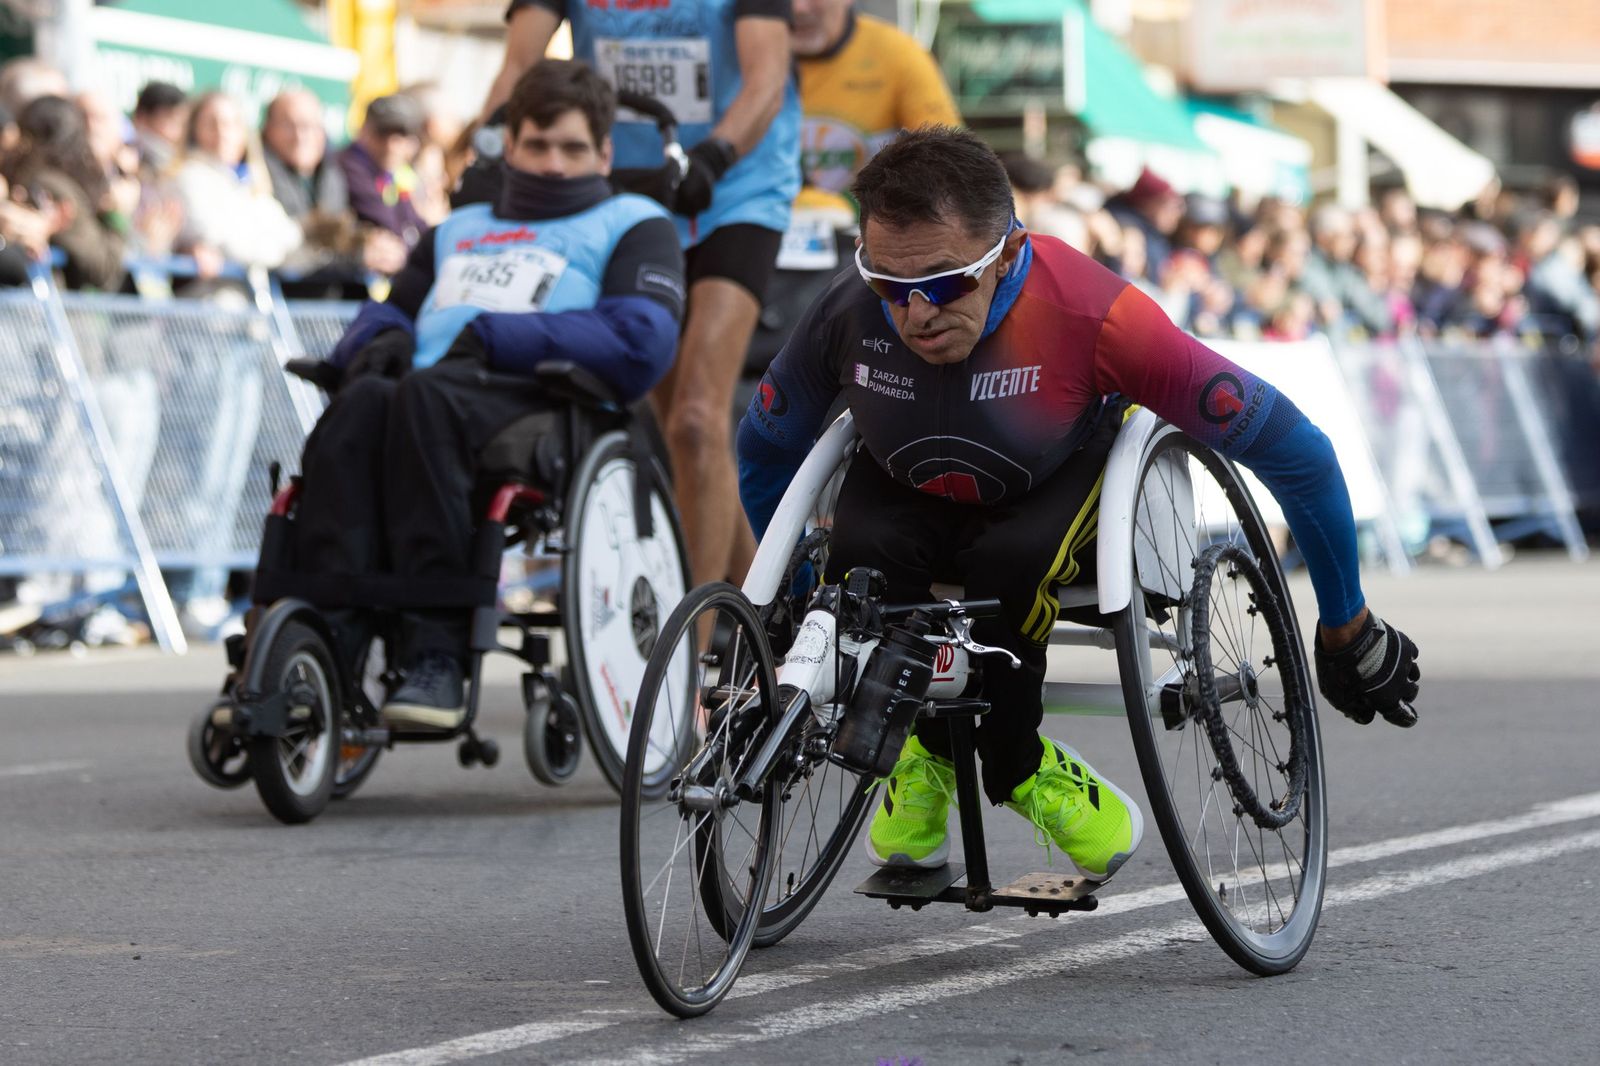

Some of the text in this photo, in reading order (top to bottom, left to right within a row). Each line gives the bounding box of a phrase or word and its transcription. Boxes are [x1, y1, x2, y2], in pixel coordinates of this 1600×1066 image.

[862, 338, 893, 354] EKT
[872, 368, 915, 388] ZARZA DE
[970, 365, 1042, 401] VICENTE
[868, 380, 916, 401] PUMAREDA
[1222, 383, 1266, 449] ANDRES
